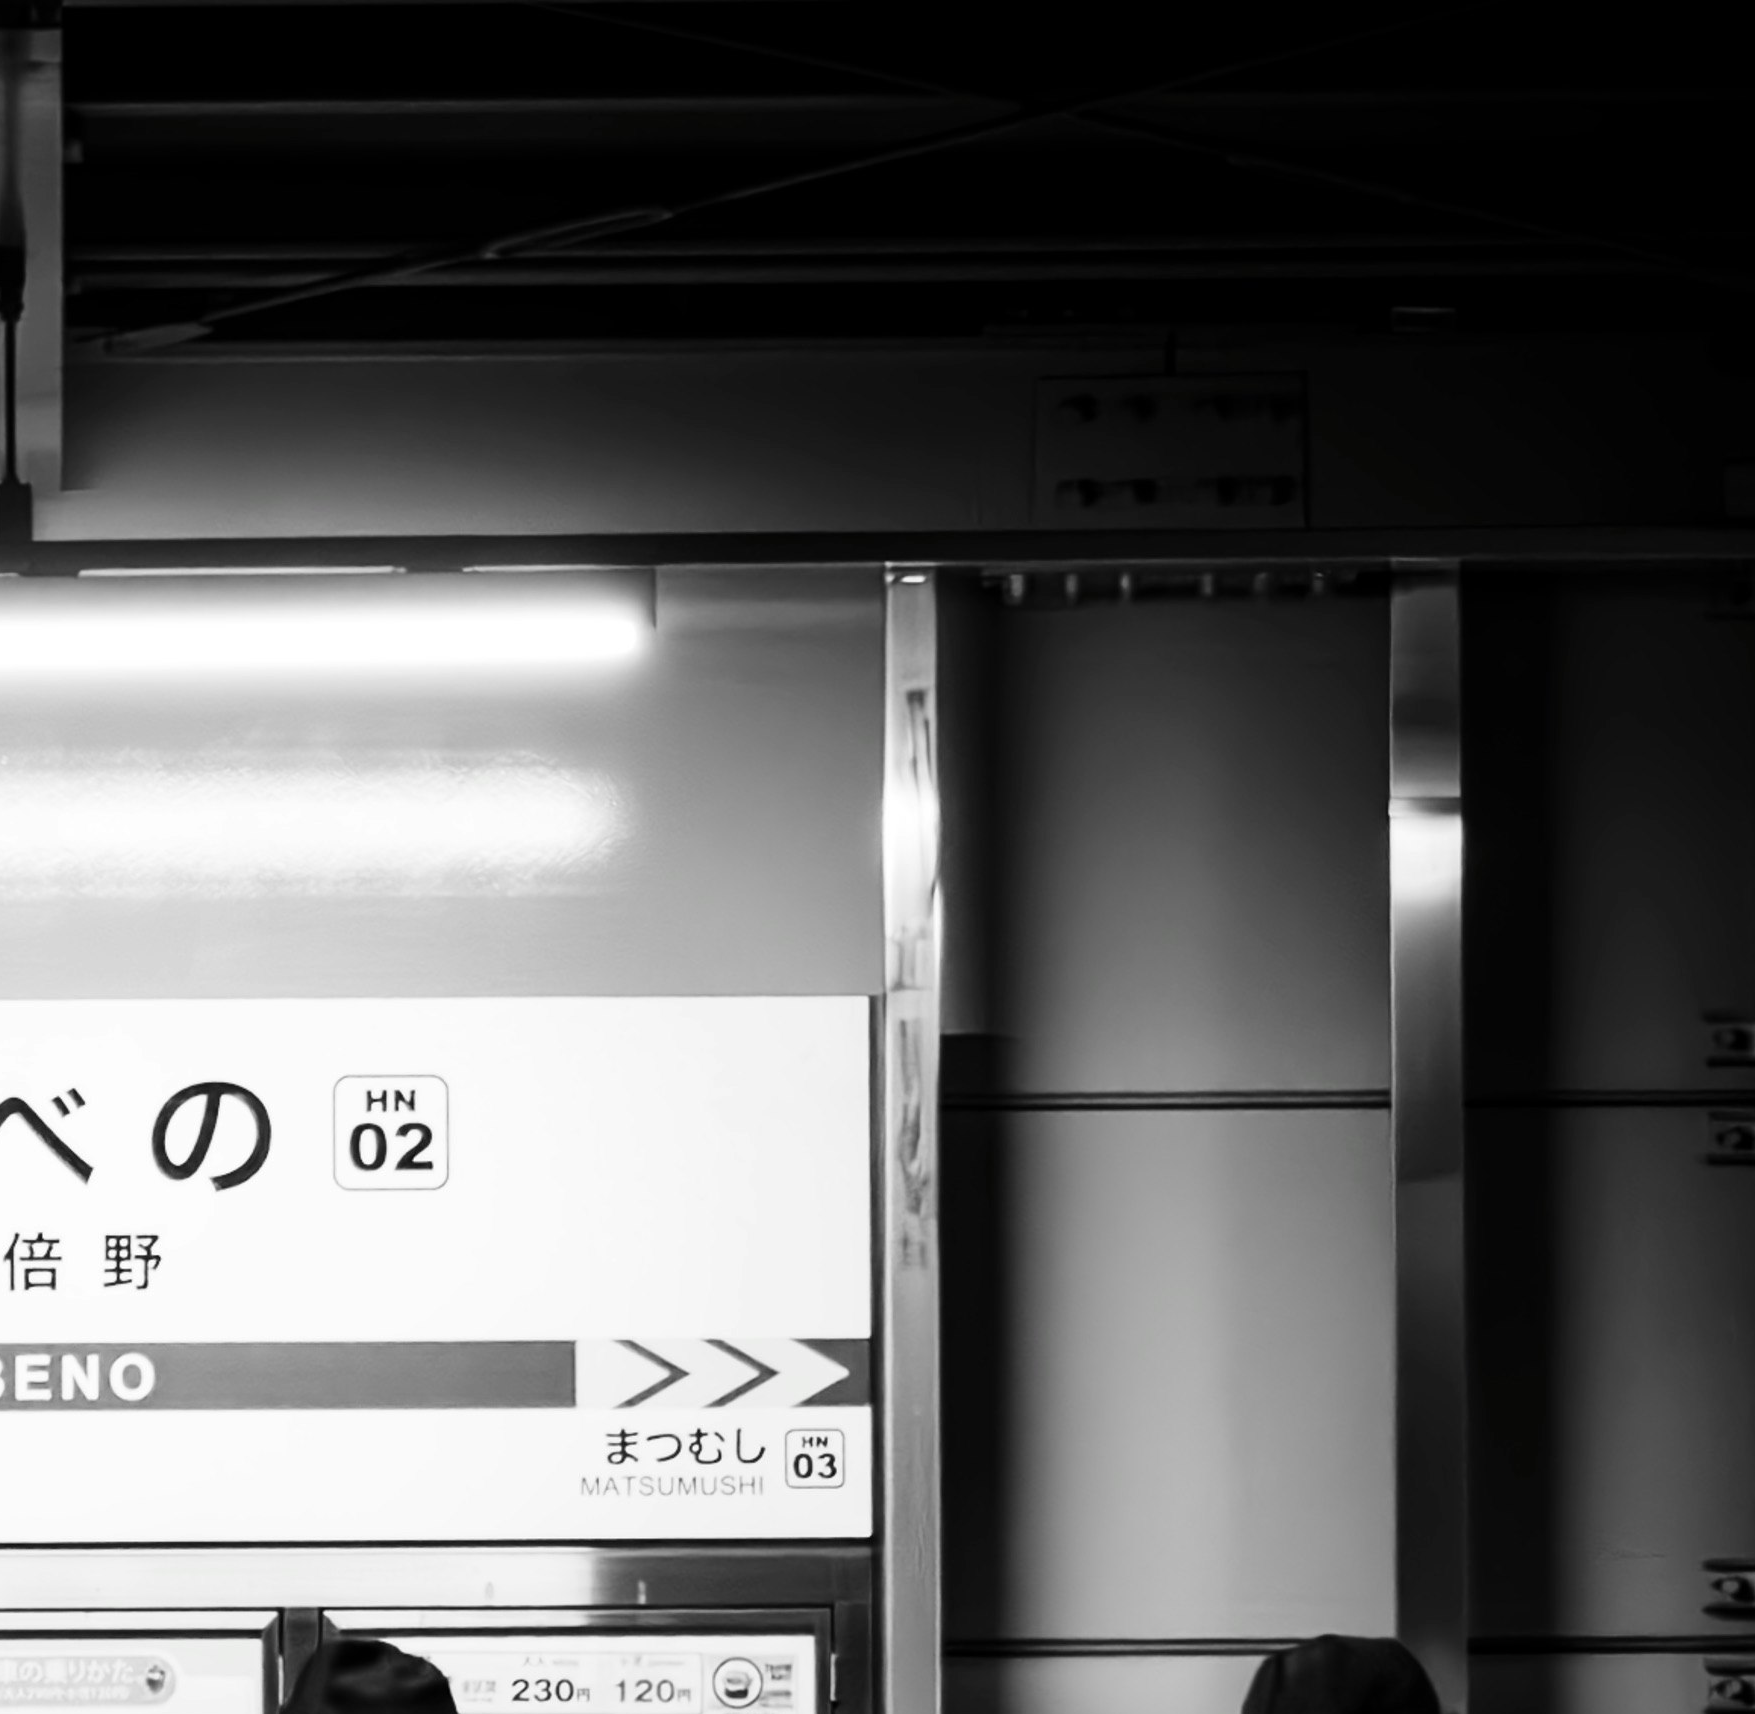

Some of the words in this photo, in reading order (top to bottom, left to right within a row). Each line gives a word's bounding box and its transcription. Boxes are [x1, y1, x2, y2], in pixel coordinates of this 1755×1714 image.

[366, 1089, 416, 1113] HN
[349, 1122, 434, 1171] 02
[605, 1427, 766, 1465] まつむし
[801, 1436, 828, 1448] HN
[793, 1453, 837, 1479] 03
[580, 1475, 765, 1497] MATSUMUSHI
